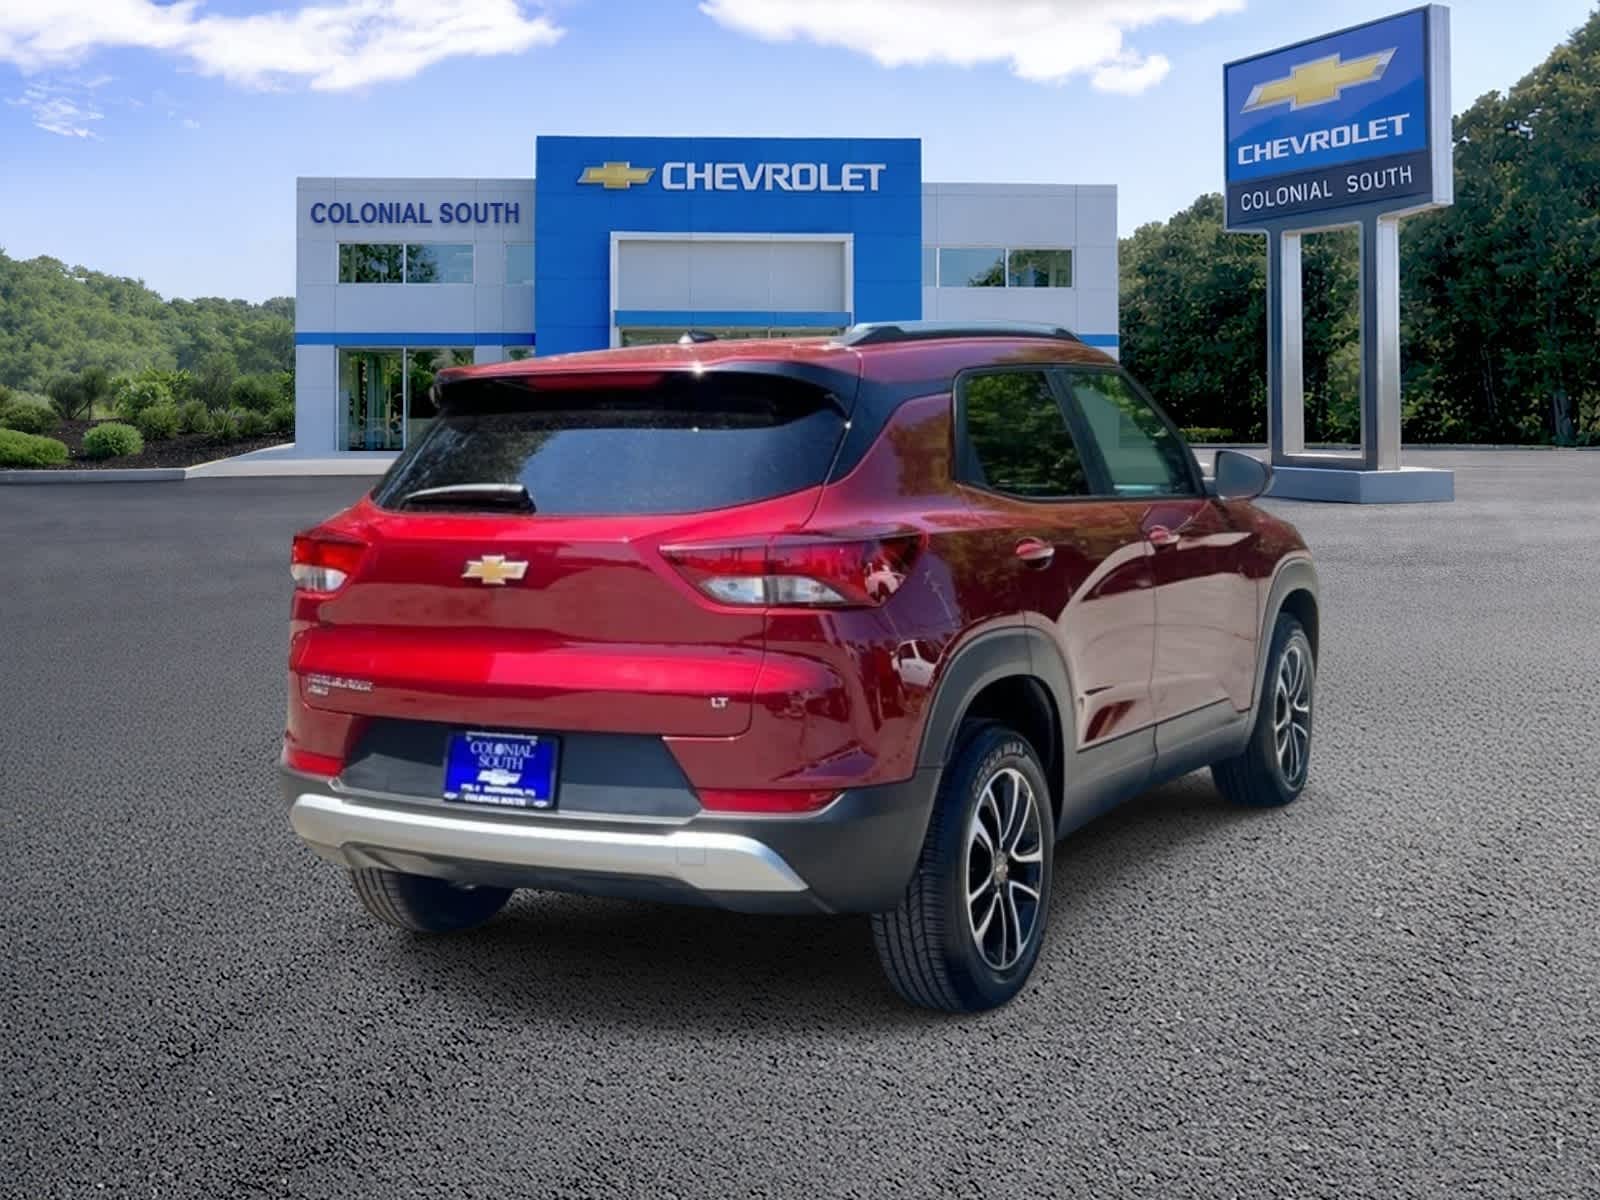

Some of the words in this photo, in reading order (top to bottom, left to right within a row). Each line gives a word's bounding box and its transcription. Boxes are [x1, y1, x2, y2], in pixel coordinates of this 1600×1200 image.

[1237, 113, 1410, 166] CHEVROLET
[661, 162, 886, 192] CHEVROLET
[1240, 180, 1333, 211] COLONIAL
[1347, 165, 1413, 193] SOUTH
[310, 202, 433, 225] COLONIAL
[439, 202, 520, 225] SOUTH
[711, 696, 729, 708] LT
[470, 740, 535, 758] COLONIAL
[478, 755, 524, 770] SOUTH
